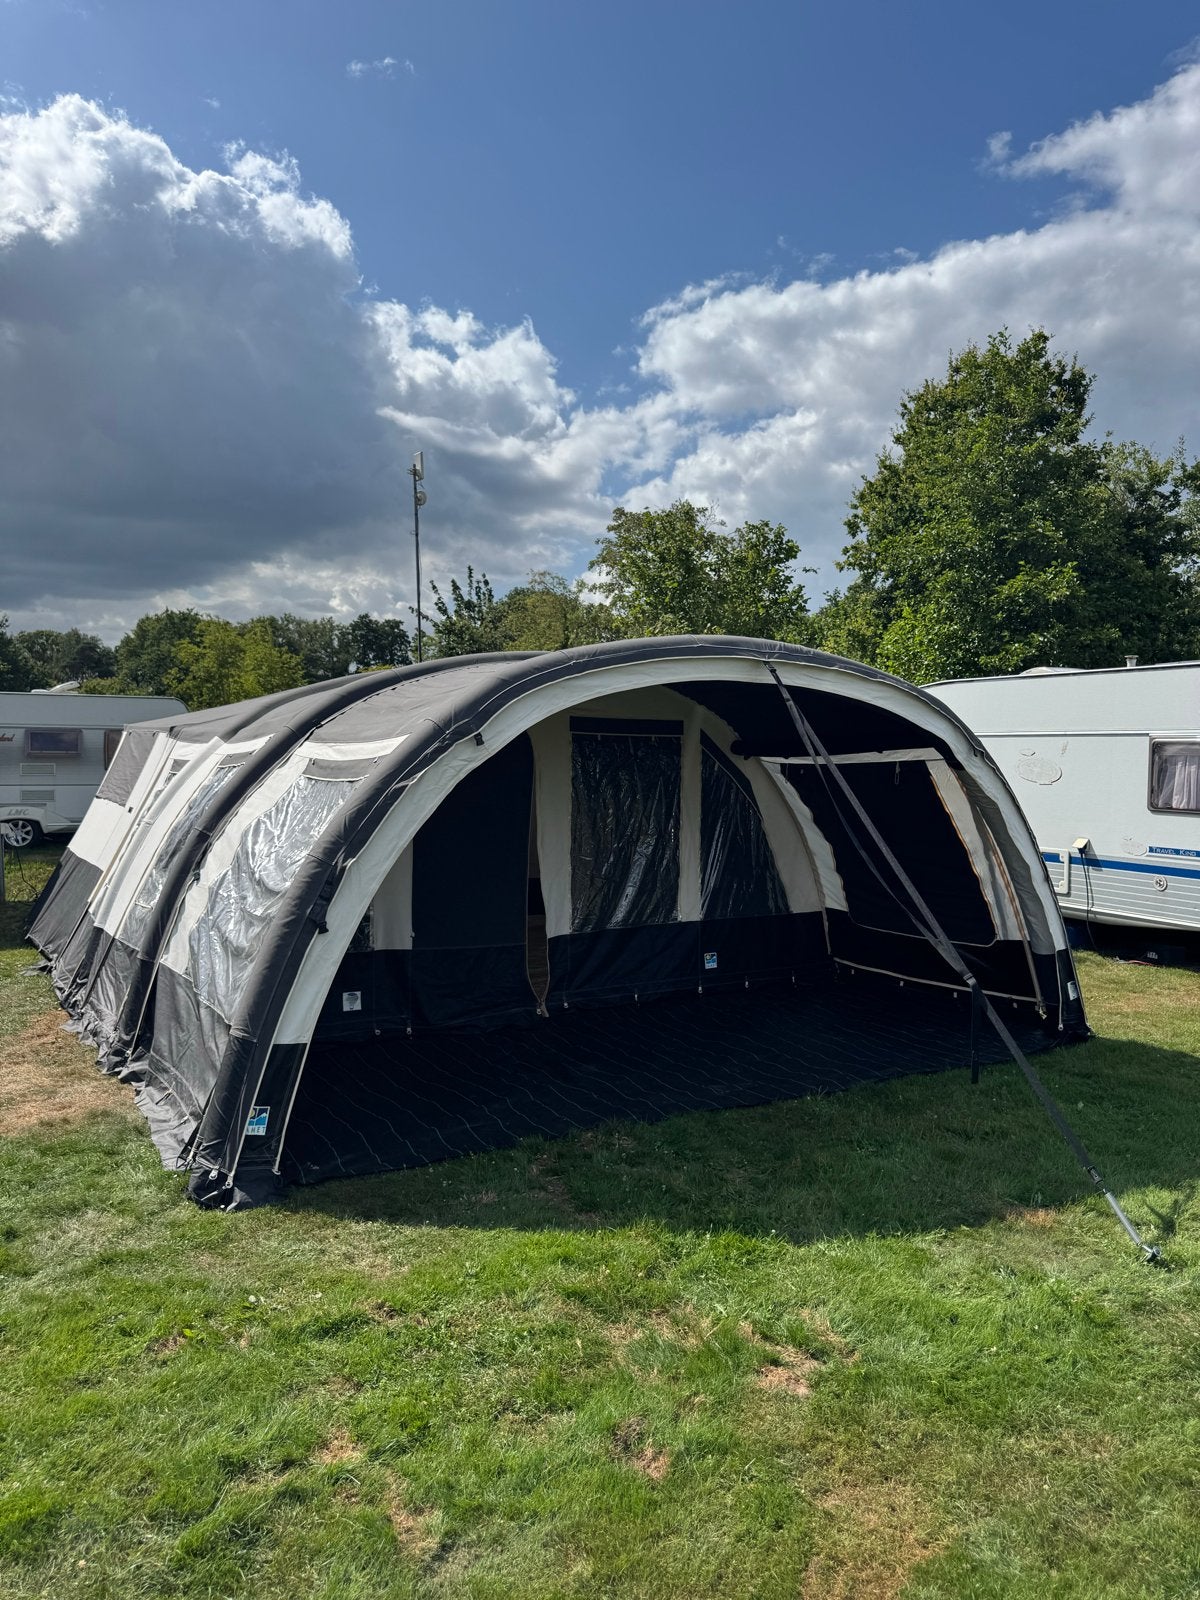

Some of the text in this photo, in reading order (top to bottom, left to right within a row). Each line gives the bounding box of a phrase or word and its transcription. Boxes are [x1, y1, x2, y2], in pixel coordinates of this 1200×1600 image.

[8, 808, 30, 817] LMC
[1152, 847, 1197, 857] TRAVEL KING
